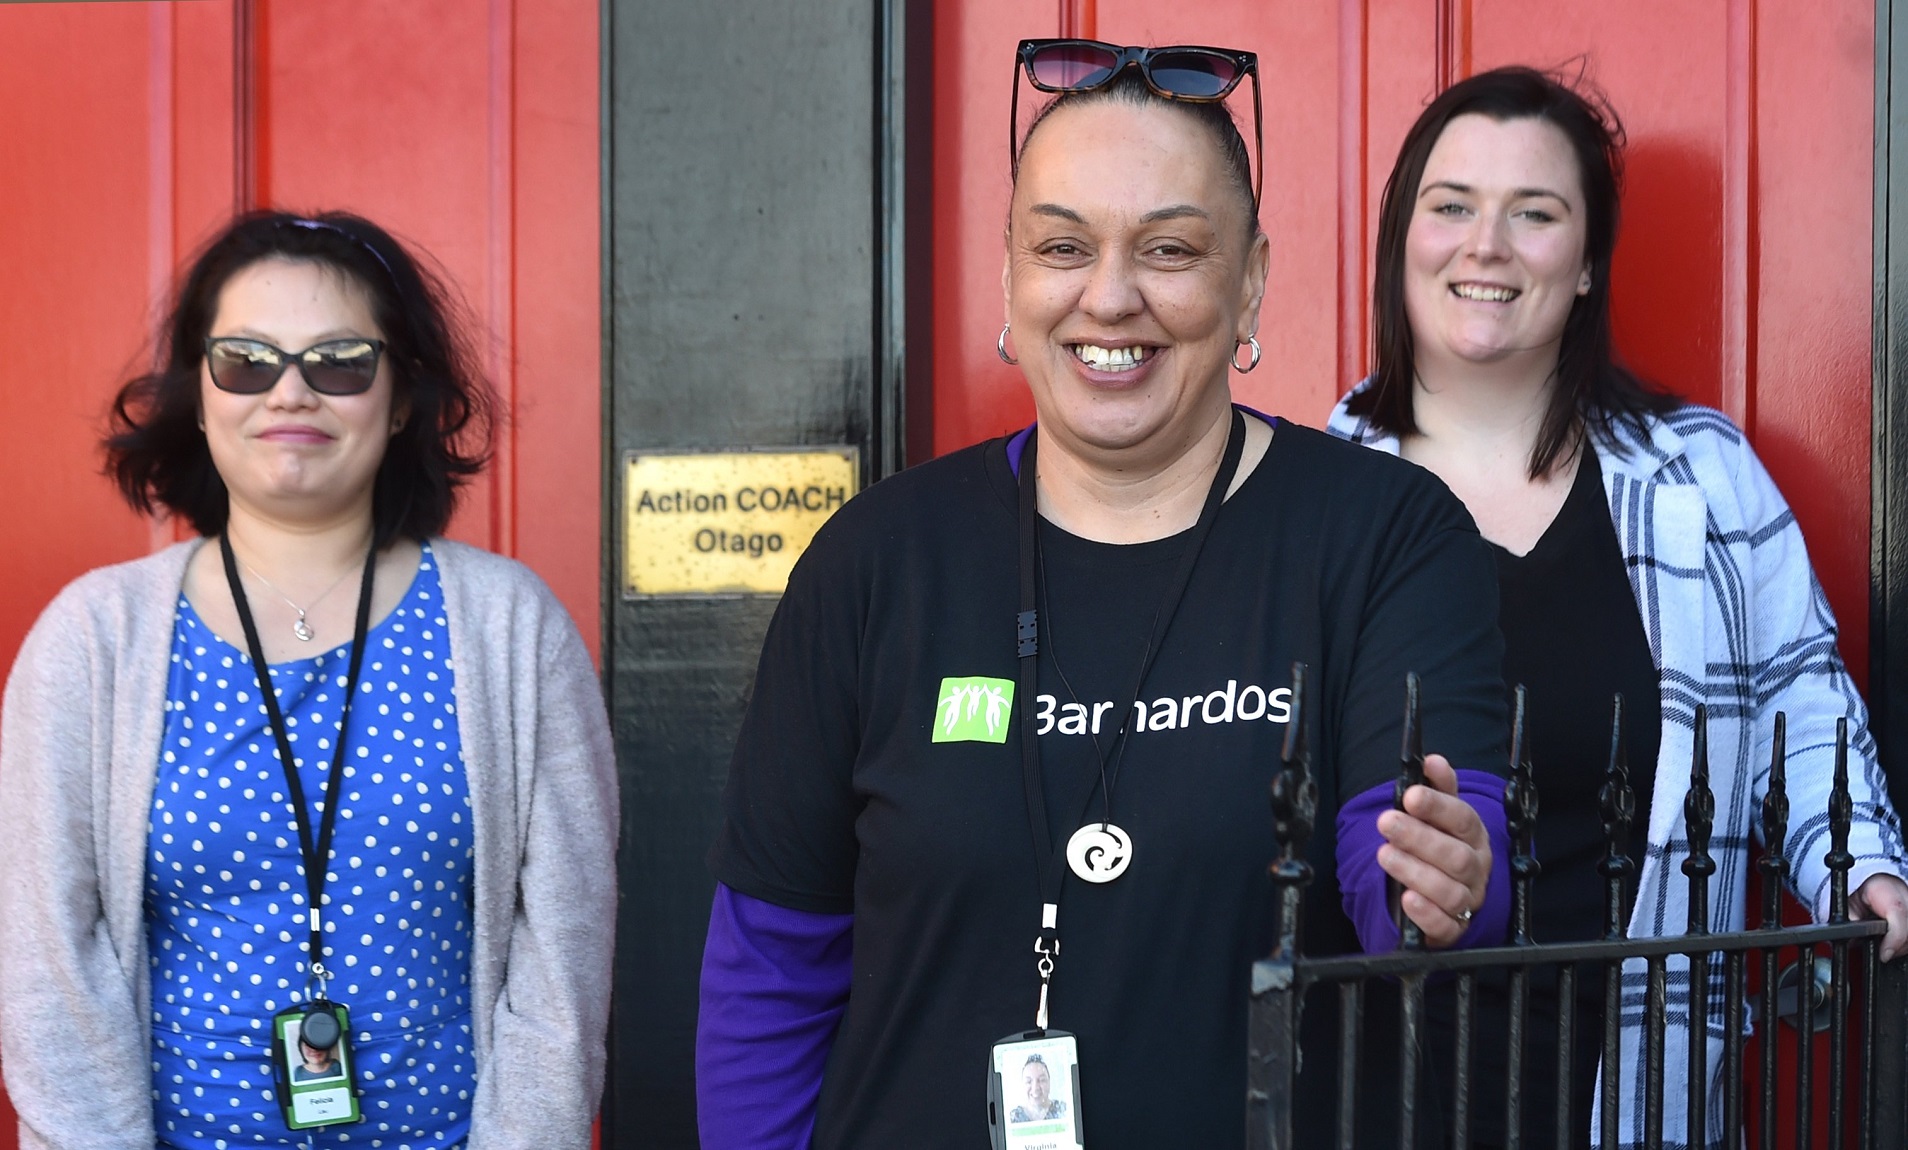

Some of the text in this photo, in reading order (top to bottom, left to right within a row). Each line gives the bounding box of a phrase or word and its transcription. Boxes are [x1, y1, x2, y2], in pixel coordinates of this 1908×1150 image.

[637, 486, 845, 513] Action COACH
[695, 528, 784, 557] Otago
